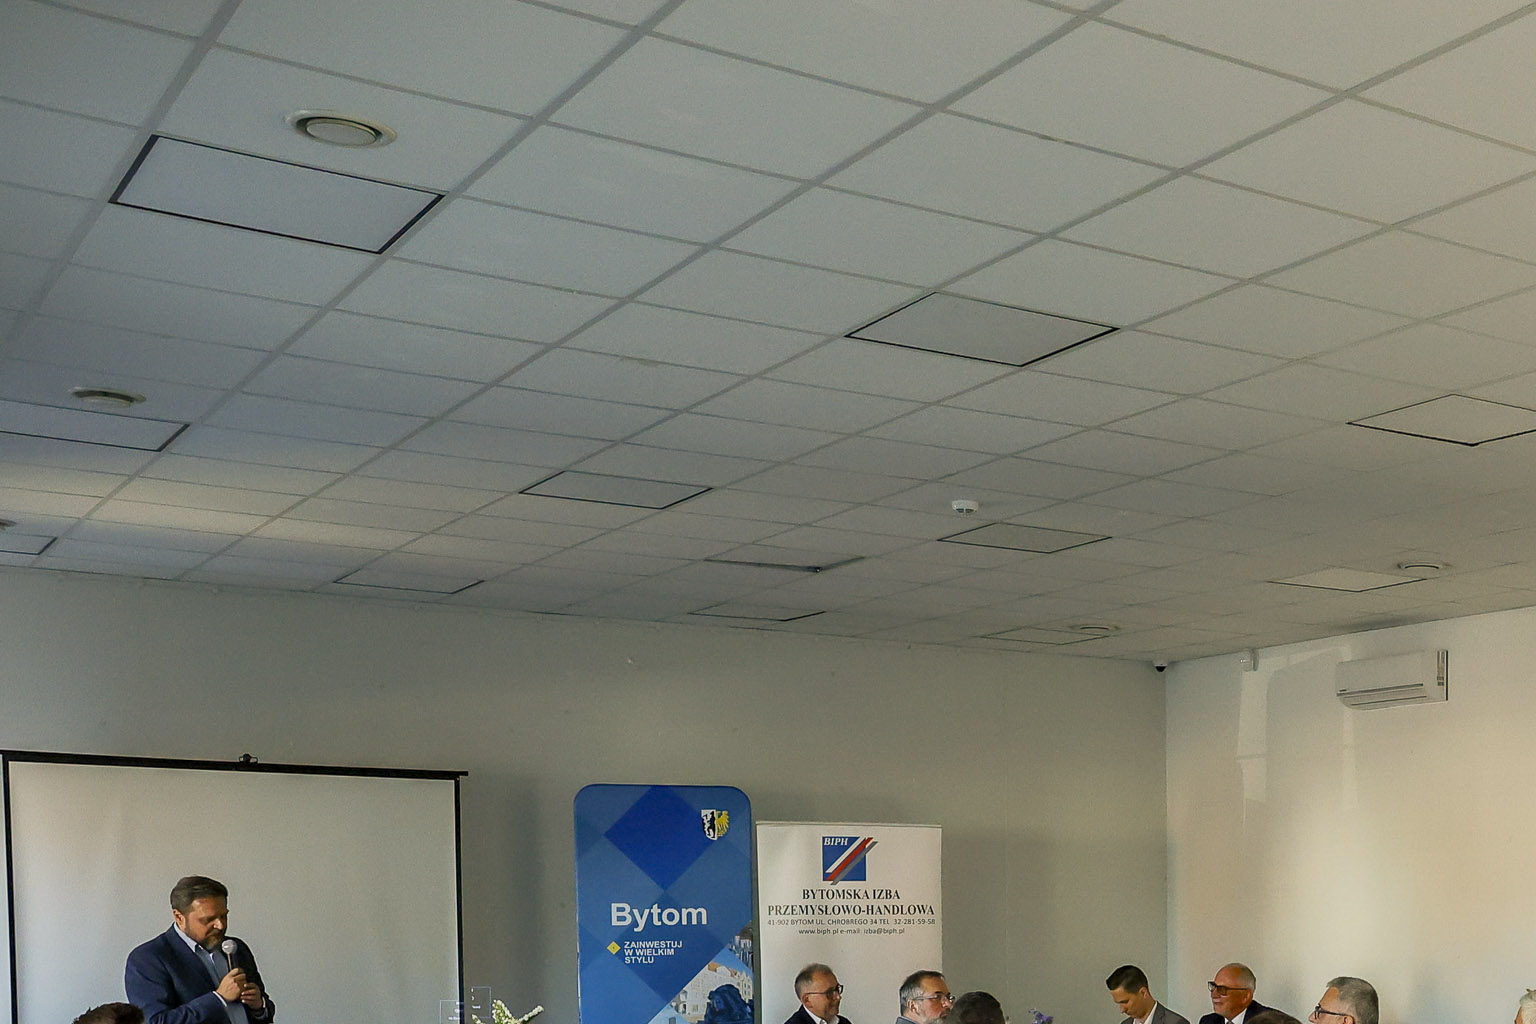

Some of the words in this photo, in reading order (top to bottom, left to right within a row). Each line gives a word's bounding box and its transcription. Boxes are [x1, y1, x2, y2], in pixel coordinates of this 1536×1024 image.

[823, 837, 849, 846] BIPH
[802, 889, 869, 900] BYTOMSKA
[872, 889, 900, 900] IZBA
[767, 904, 935, 916] PRZEMYSŁOWO-HANDLOWA
[611, 902, 707, 932] Bytom
[790, 918, 815, 926] BYTOM
[624, 940, 683, 949] ZAINWESTUJ
[624, 948, 633, 956] W
[635, 948, 675, 956] WIELKIM
[624, 956, 655, 964] STYLU
